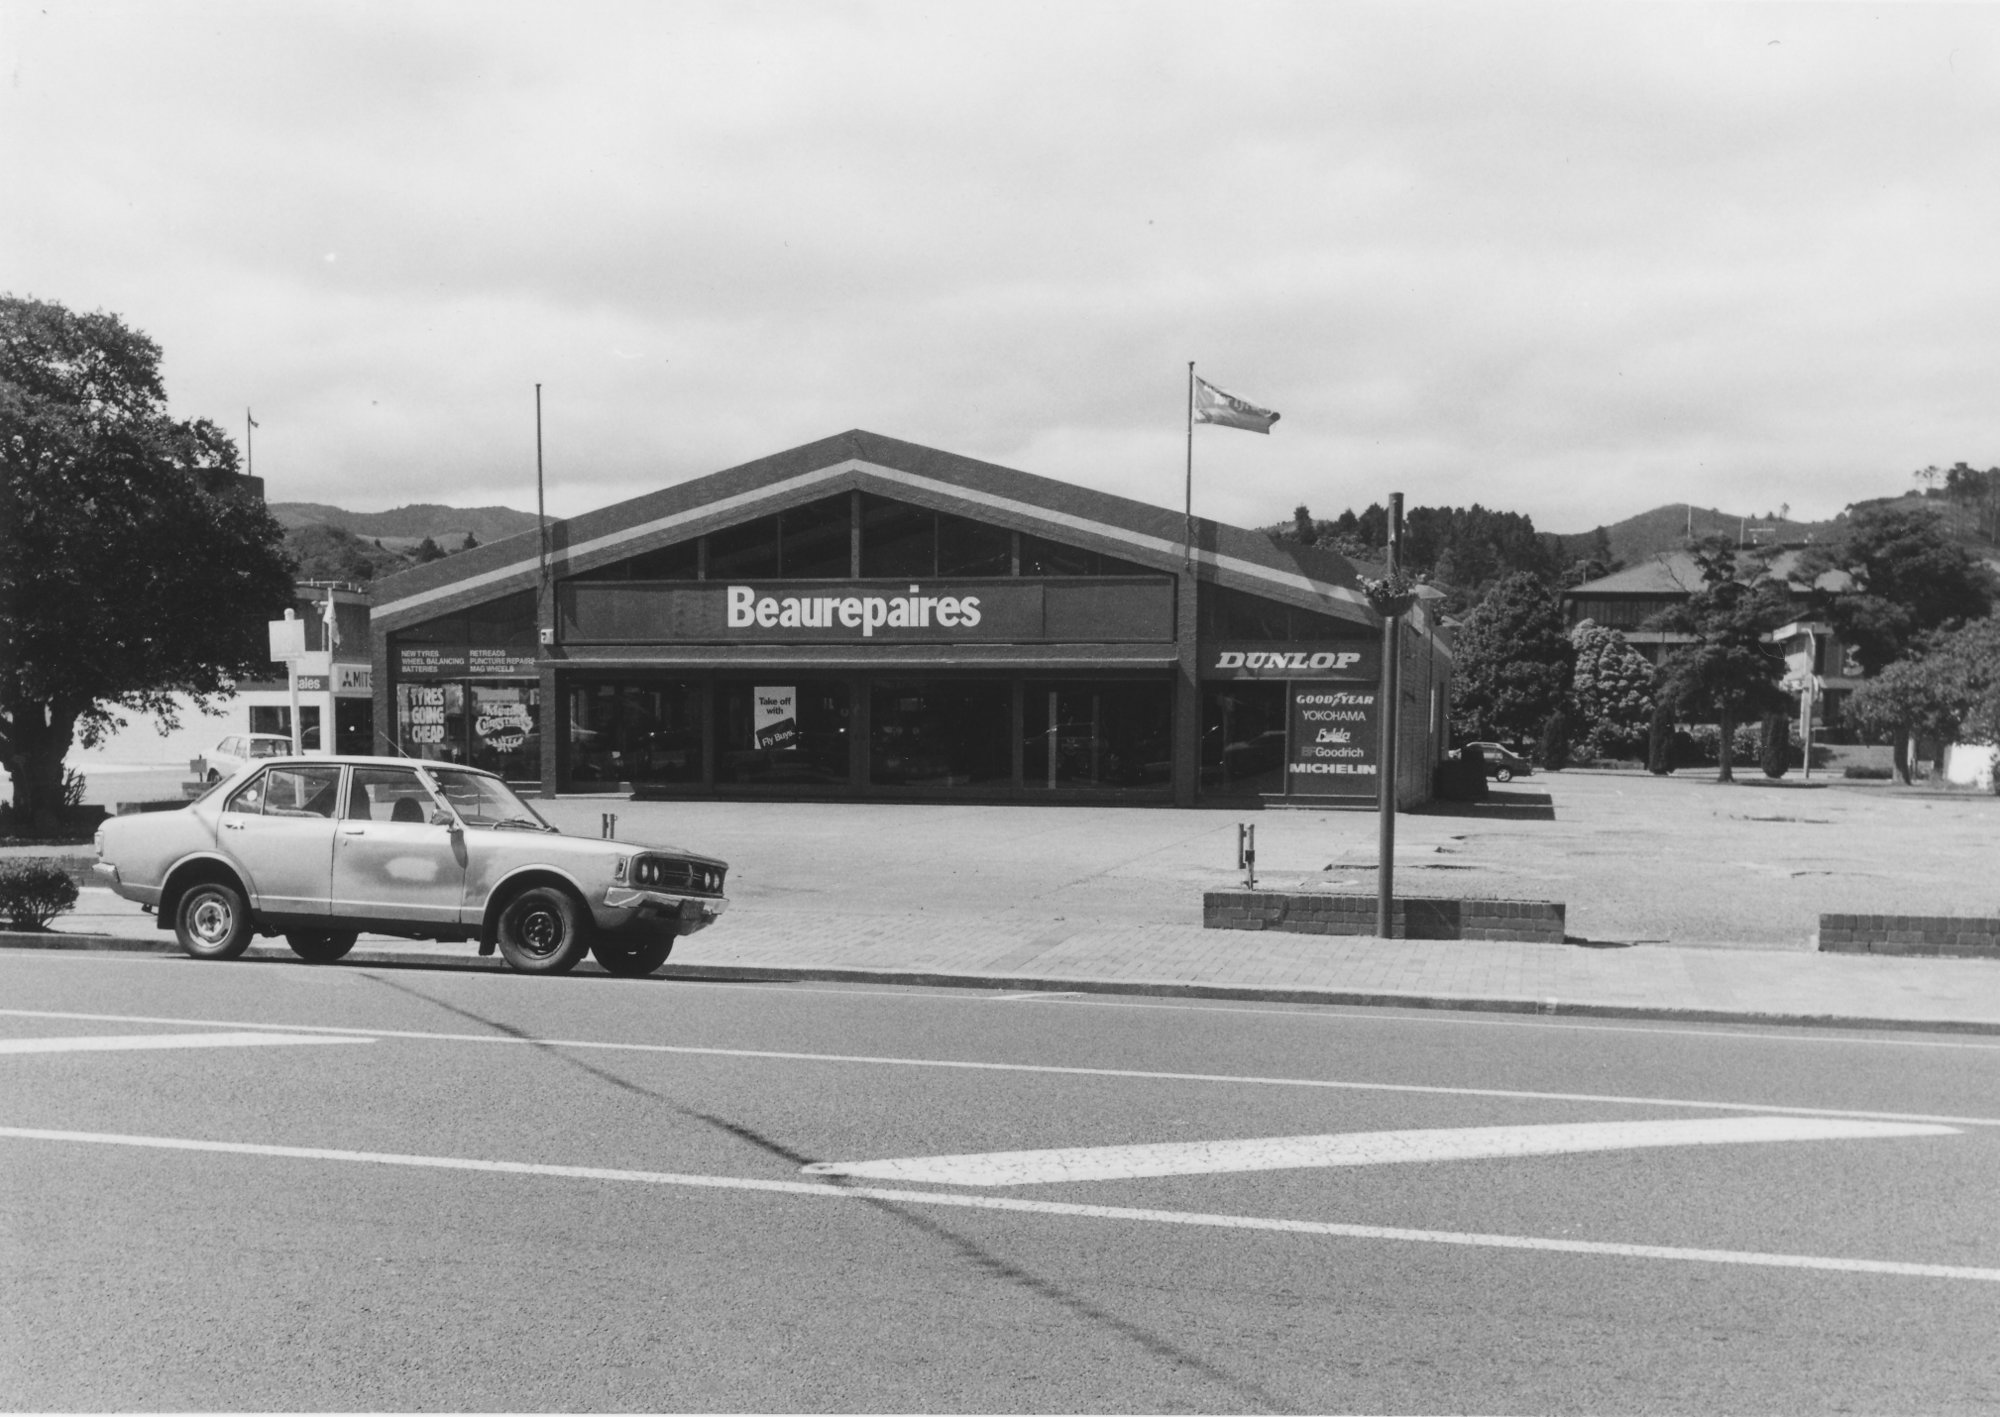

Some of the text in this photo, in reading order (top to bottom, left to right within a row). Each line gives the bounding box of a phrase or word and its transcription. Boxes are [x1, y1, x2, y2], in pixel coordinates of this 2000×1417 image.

[728, 585, 981, 637] Beaurepaires
[1215, 652, 1361, 669] DUNLOP
[298, 676, 321, 690] ales
[410, 687, 445, 706] TYRES
[759, 697, 792, 706] Take off
[1296, 692, 1374, 707] GOODYEAR
[412, 706, 445, 724] GOING
[766, 707, 784, 715] with
[1302, 710, 1366, 721] YOKOHAMA
[412, 725, 445, 744] CHEAP
[762, 736, 774, 748] Fly
[1289, 763, 1377, 775] MICHELIN
